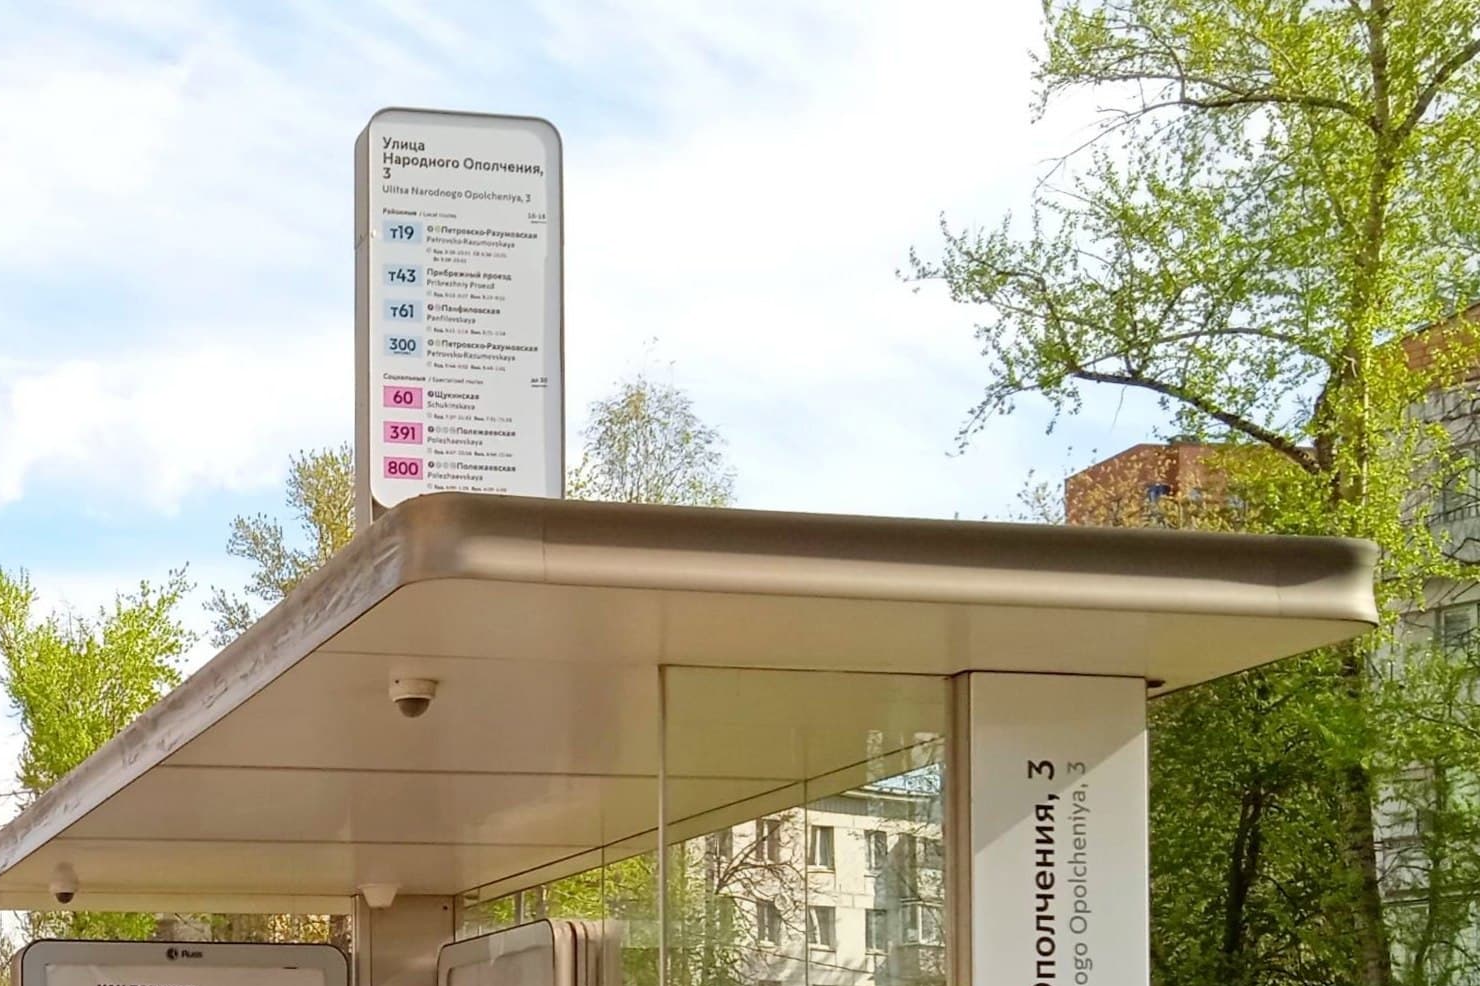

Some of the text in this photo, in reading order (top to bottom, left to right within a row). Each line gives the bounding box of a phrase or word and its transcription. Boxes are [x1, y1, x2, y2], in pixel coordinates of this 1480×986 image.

[382, 136, 426, 153] Улица
[382, 152, 544, 177] Народного Ополчения,
[382, 167, 392, 180] 3
[382, 185, 410, 195] Ulitsa
[411, 187, 463, 200] Narodnogo
[389, 337, 416, 352] 300
[393, 390, 413, 405] 60
[389, 425, 416, 441] 391
[387, 460, 419, 476] 800
[1027, 759, 1056, 780] 3
[1067, 761, 1086, 775] 3
[1067, 782, 1092, 935] Opolcheniya,
